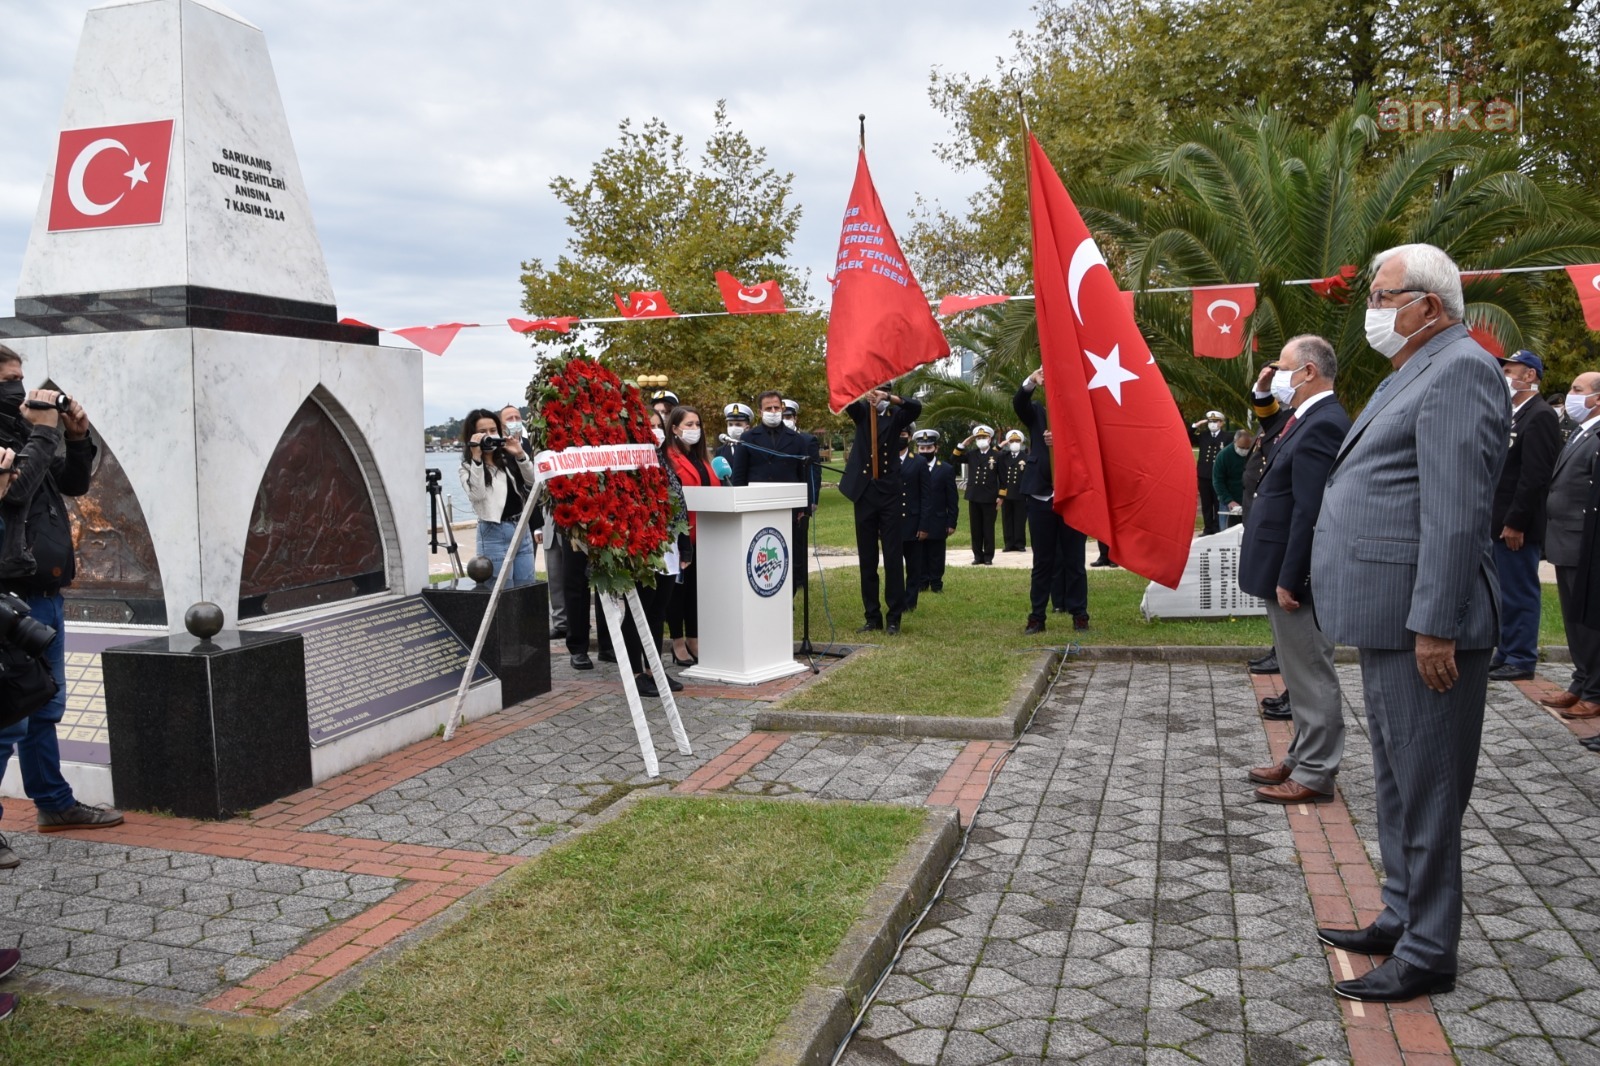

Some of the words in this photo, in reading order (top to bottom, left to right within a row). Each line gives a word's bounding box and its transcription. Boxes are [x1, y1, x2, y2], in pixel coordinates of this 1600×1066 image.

[222, 148, 272, 174] SARIKAMIŞ
[212, 161, 241, 180] DENİZ
[242, 170, 286, 191] ŞEHİTLERİ
[235, 184, 271, 203] ANISINA
[224, 198, 230, 210] 7
[232, 200, 262, 216] KASIM
[264, 208, 285, 222] 1914
[845, 206, 860, 218] EB
[844, 234, 884, 246] ERDEM
[557, 452, 583, 470] KASIM
[582, 450, 617, 469] SARIKAMIŞ
